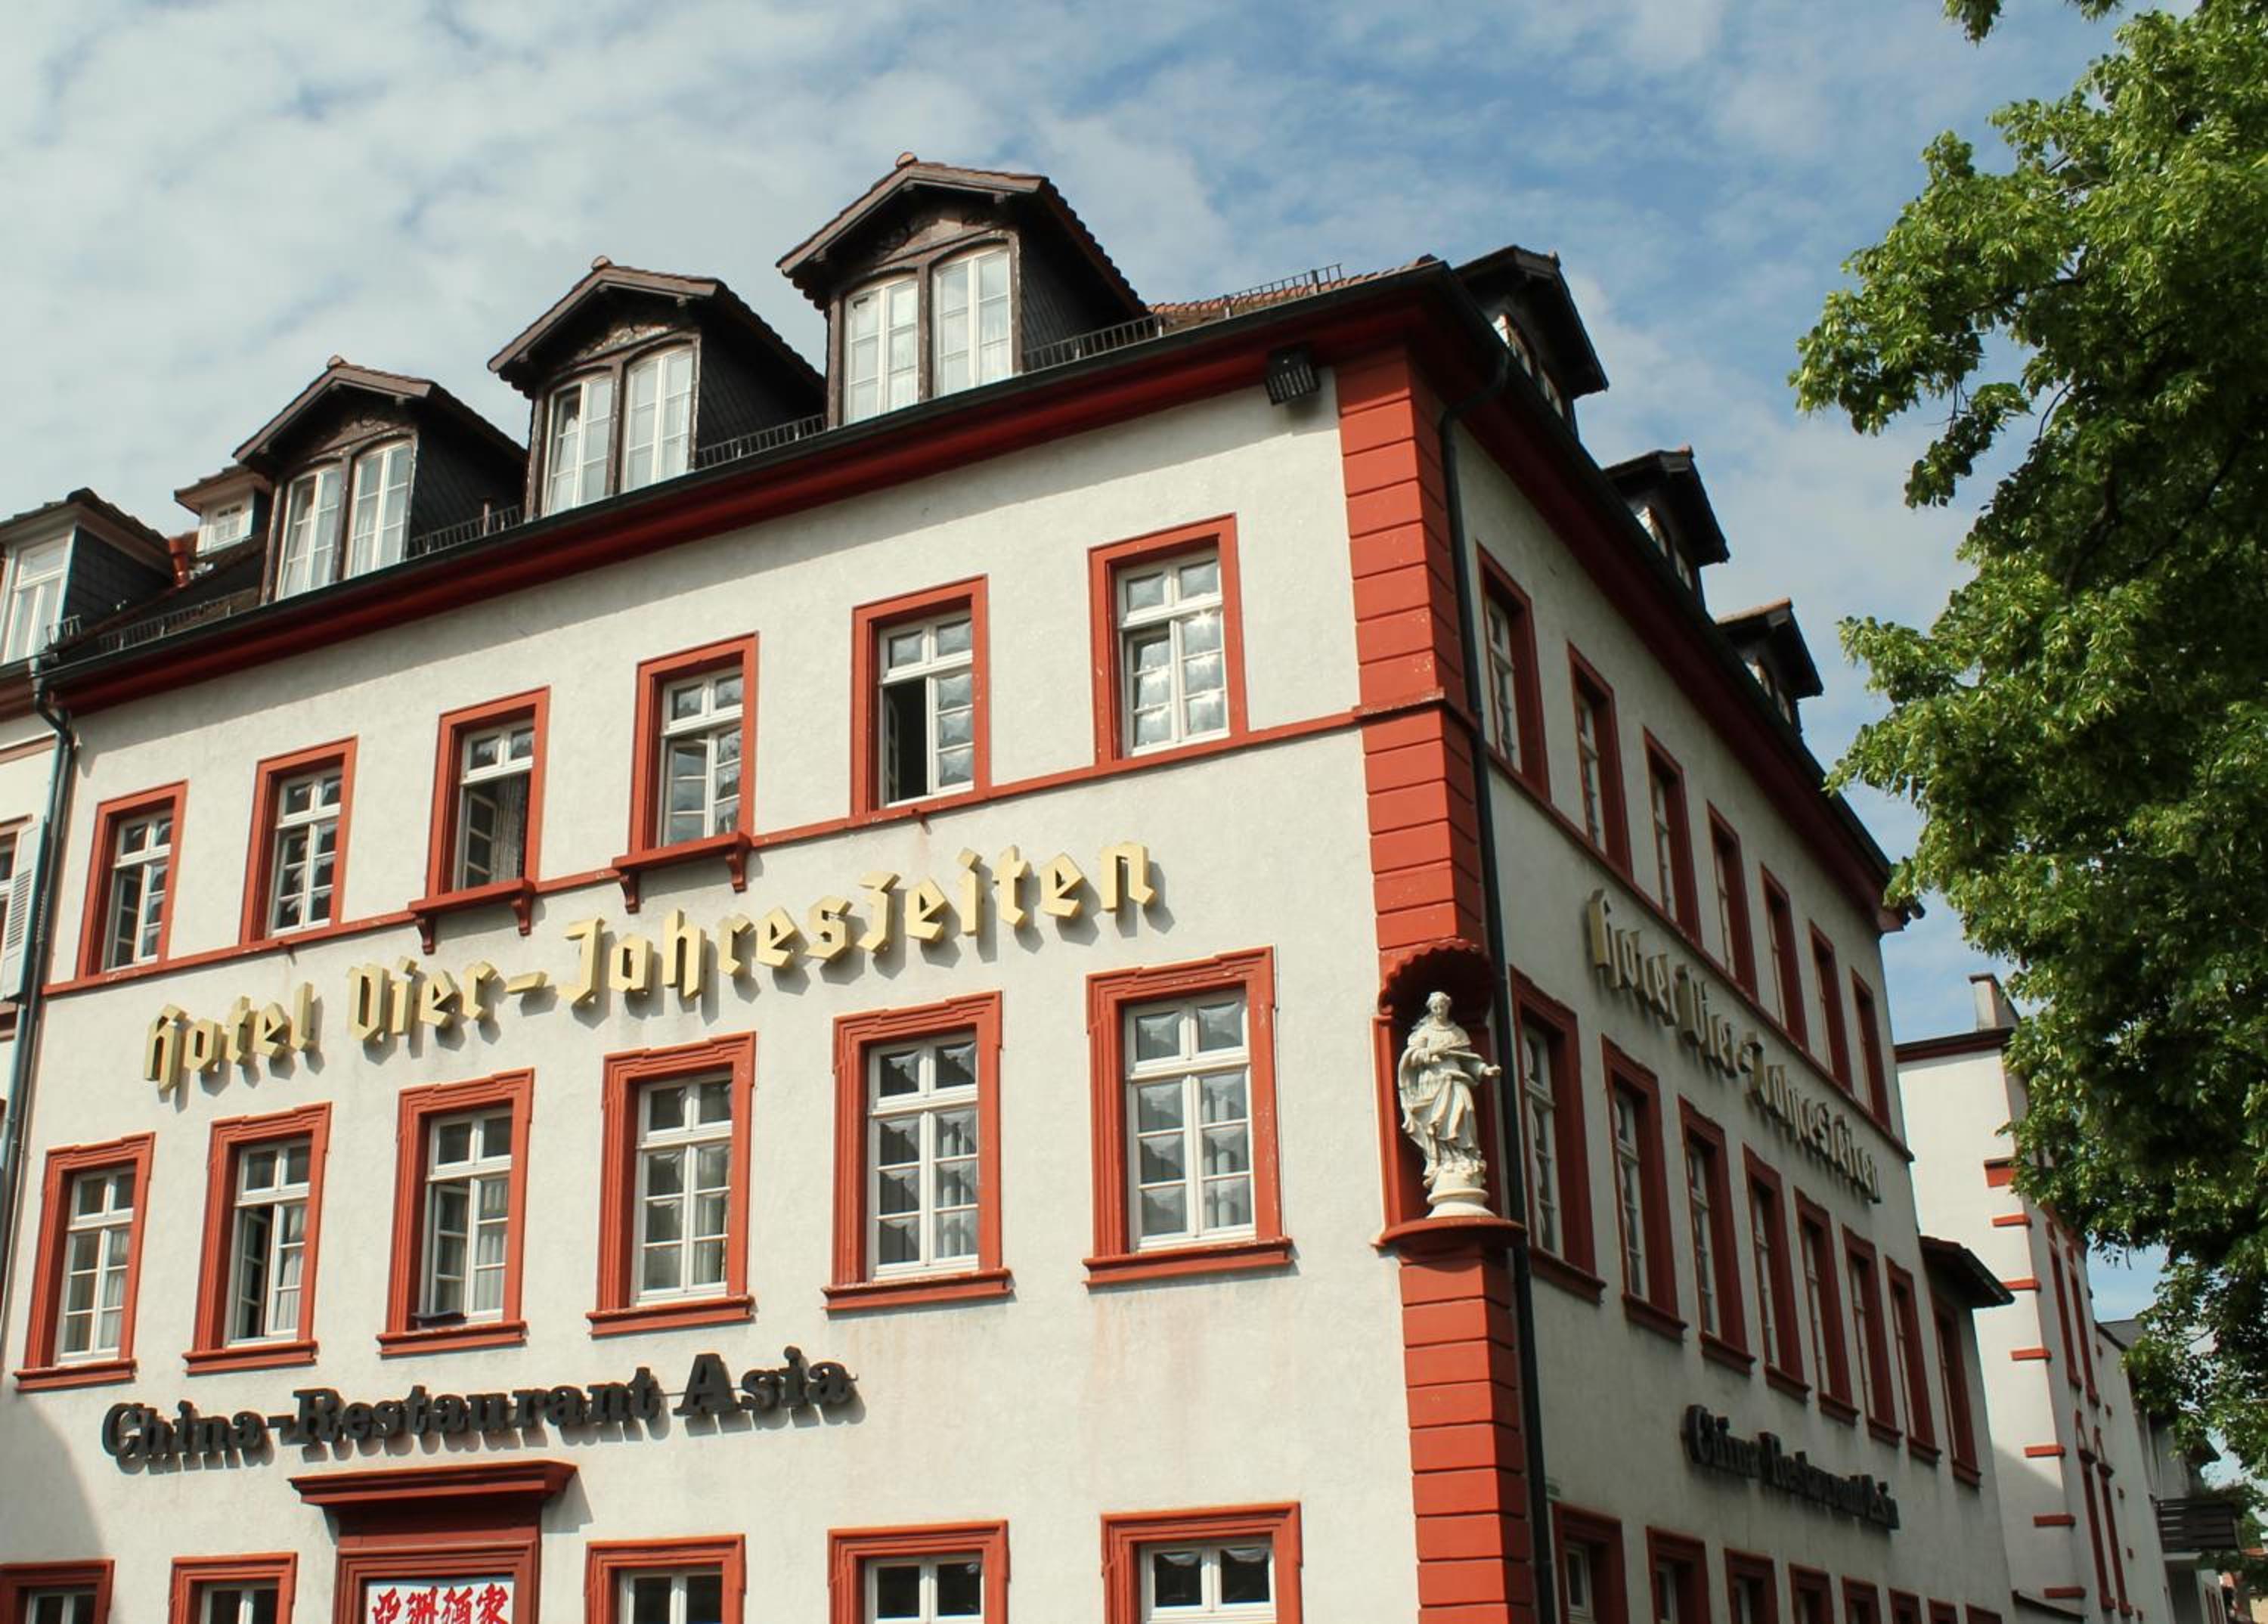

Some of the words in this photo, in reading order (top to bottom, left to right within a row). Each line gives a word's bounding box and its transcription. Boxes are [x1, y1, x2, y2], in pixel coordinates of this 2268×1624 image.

[144, 982, 315, 1092] Hotel
[101, 1365, 662, 1459] China-Restaurant
[672, 1346, 855, 1418] Asia
